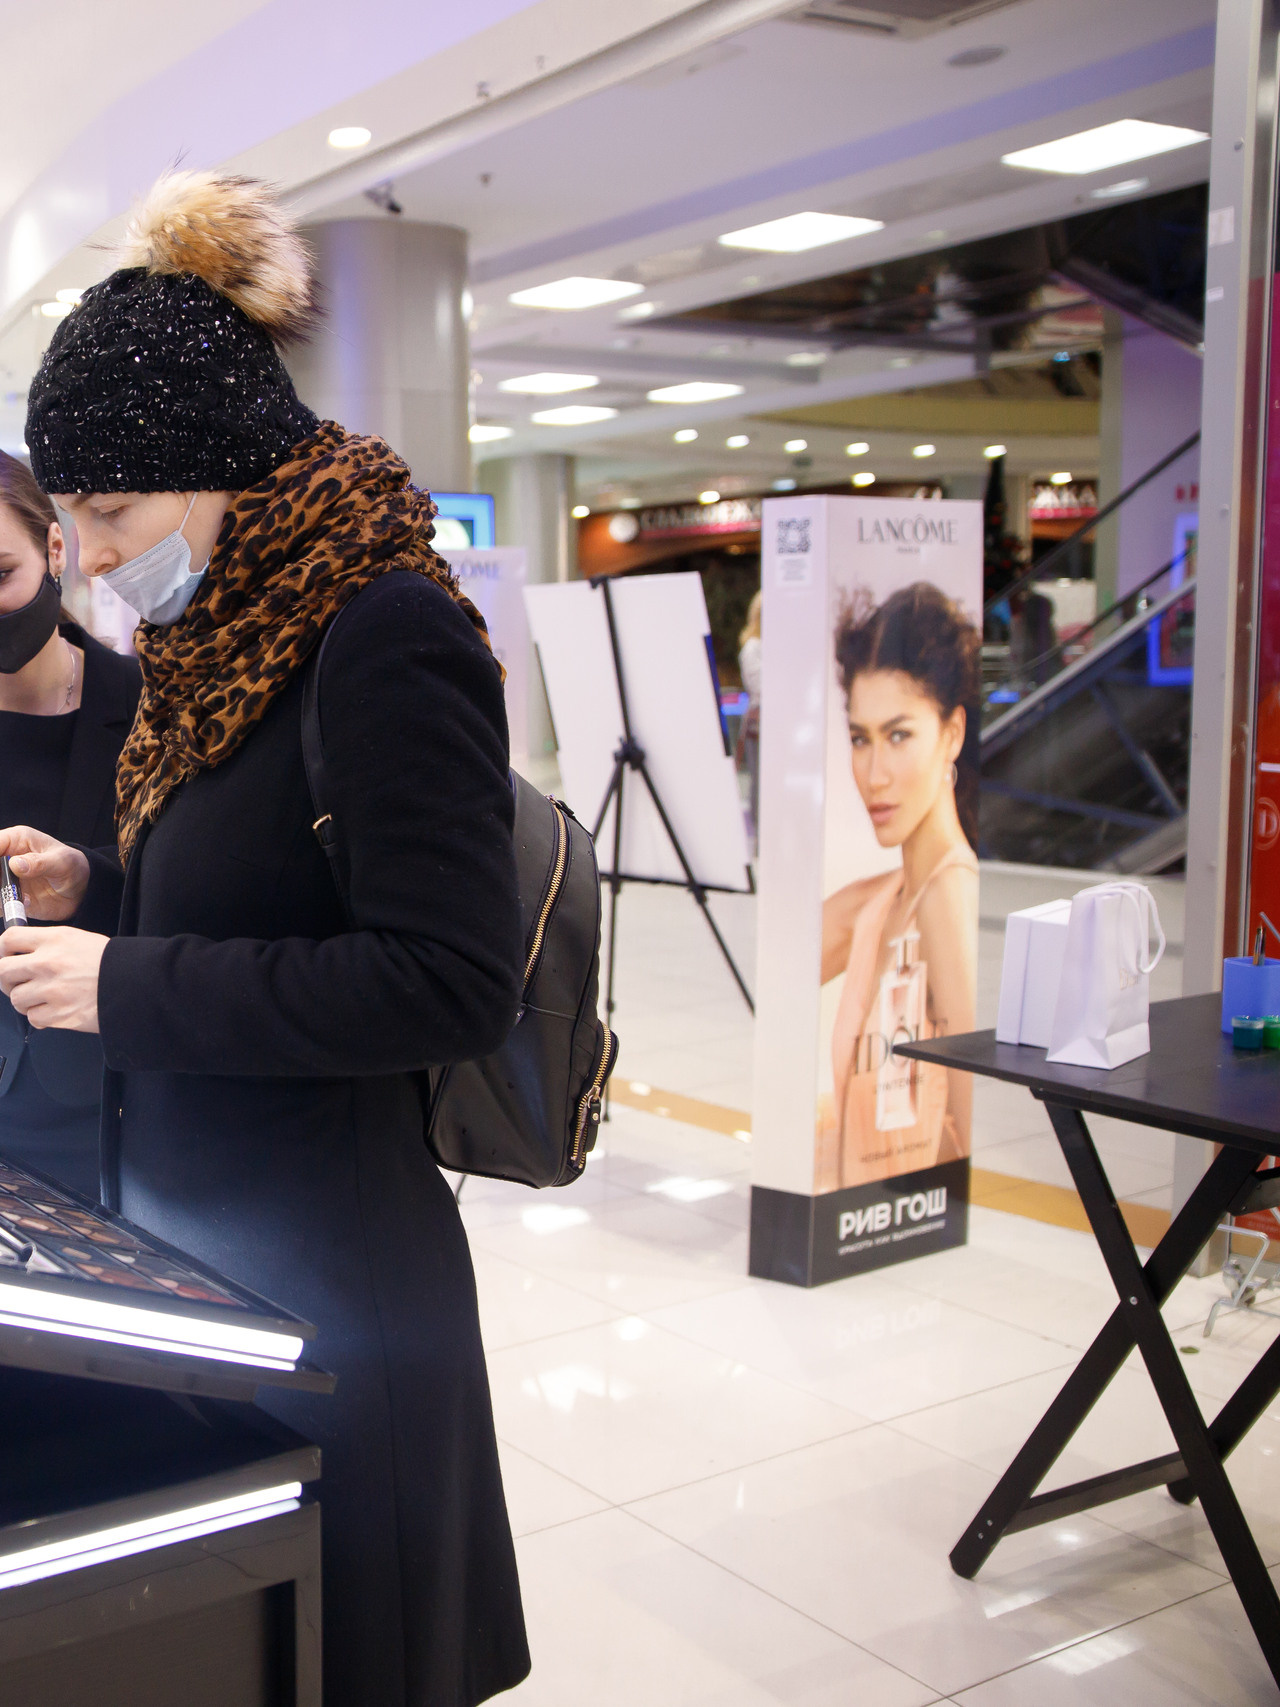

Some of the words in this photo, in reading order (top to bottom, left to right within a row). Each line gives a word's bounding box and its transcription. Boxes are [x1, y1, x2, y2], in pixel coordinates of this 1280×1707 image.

[857, 513, 959, 544] LANCÔME
[838, 1202, 892, 1242] РИВ
[894, 1186, 948, 1226] ГОШ
